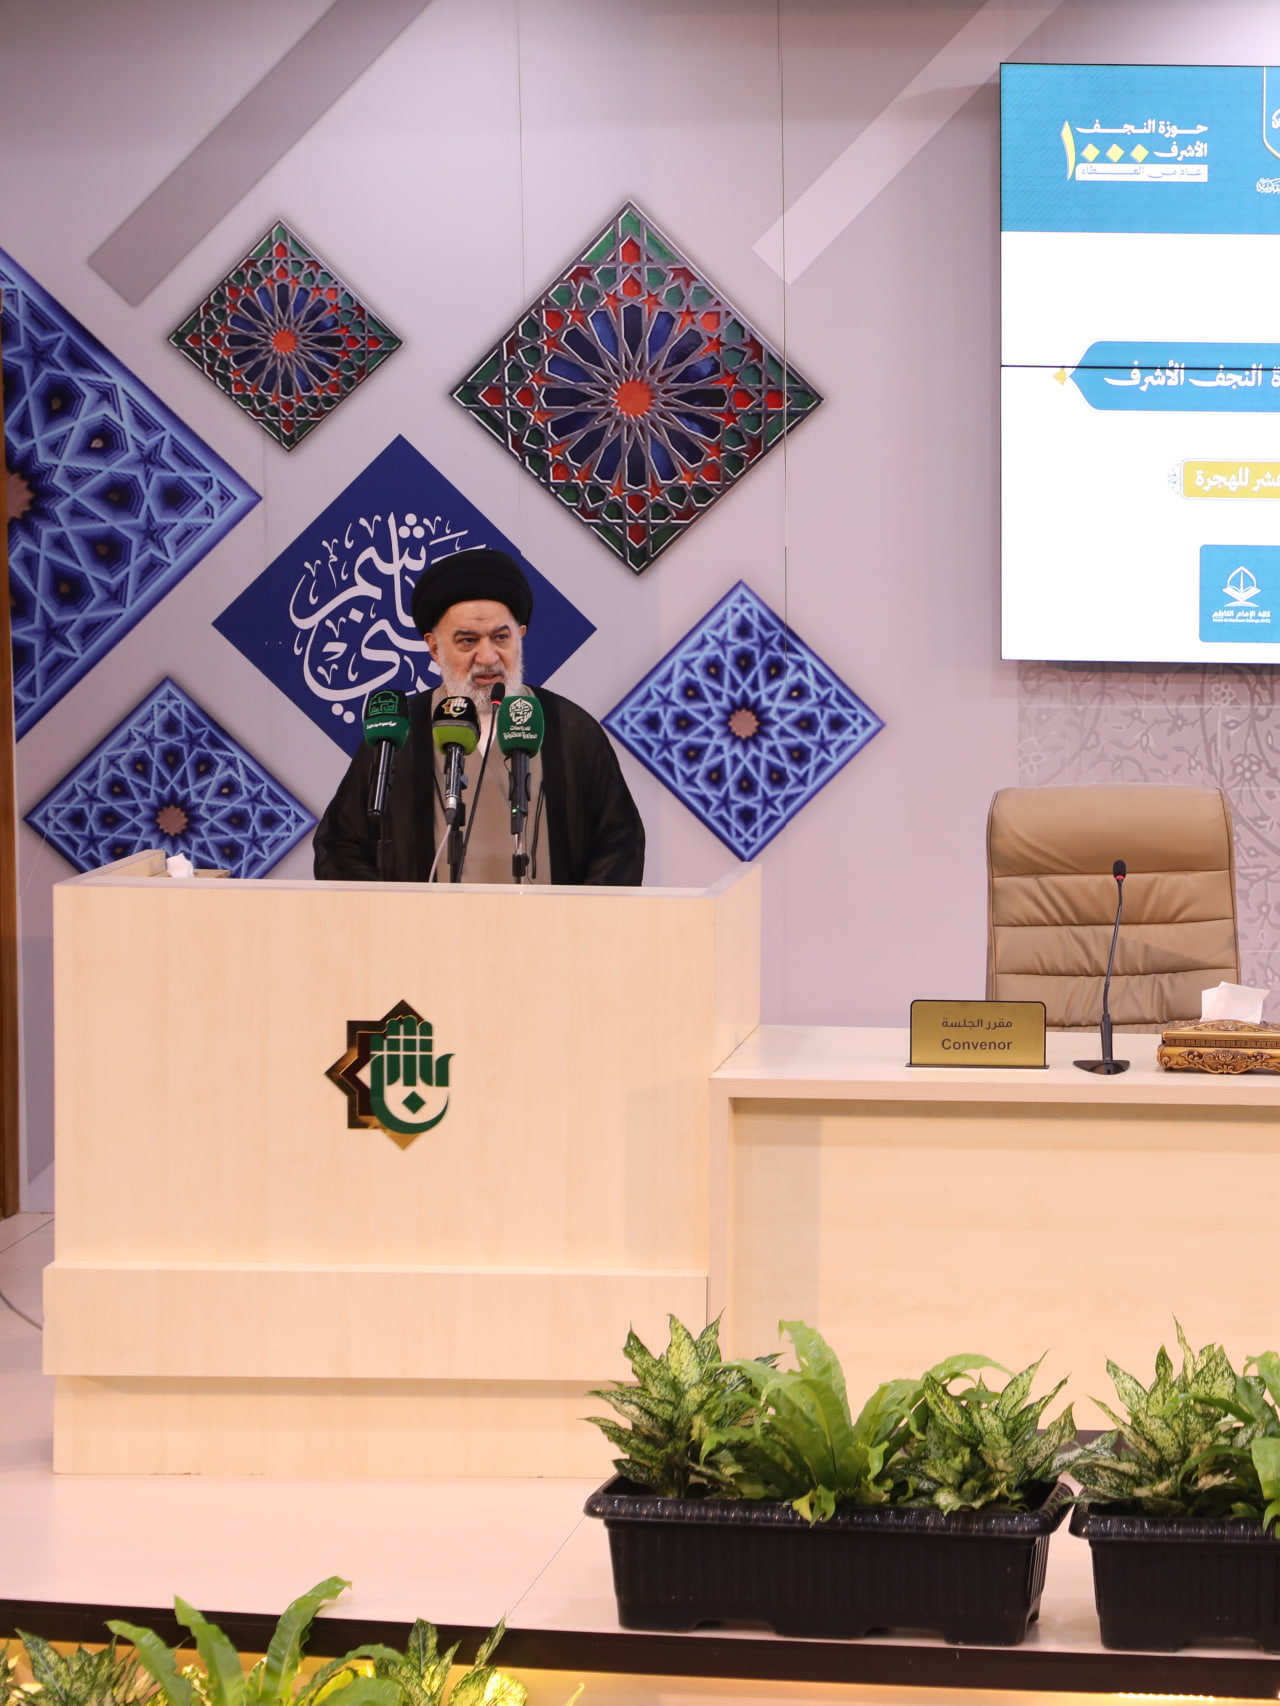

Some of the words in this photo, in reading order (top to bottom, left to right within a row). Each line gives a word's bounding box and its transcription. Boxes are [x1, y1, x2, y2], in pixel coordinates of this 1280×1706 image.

[1075, 118, 1156, 136] النجف
[1158, 120, 1209, 138] حوزة
[1153, 141, 1208, 161] الأشرف
[1104, 361, 1185, 391] الأشرف
[1188, 364, 1263, 390] النجف
[1194, 468, 1249, 490] للهجرة
[942, 1017, 983, 1030] الجلسة
[986, 1020, 1013, 1031] مقرر
[941, 1038, 1013, 1051] Convenor
